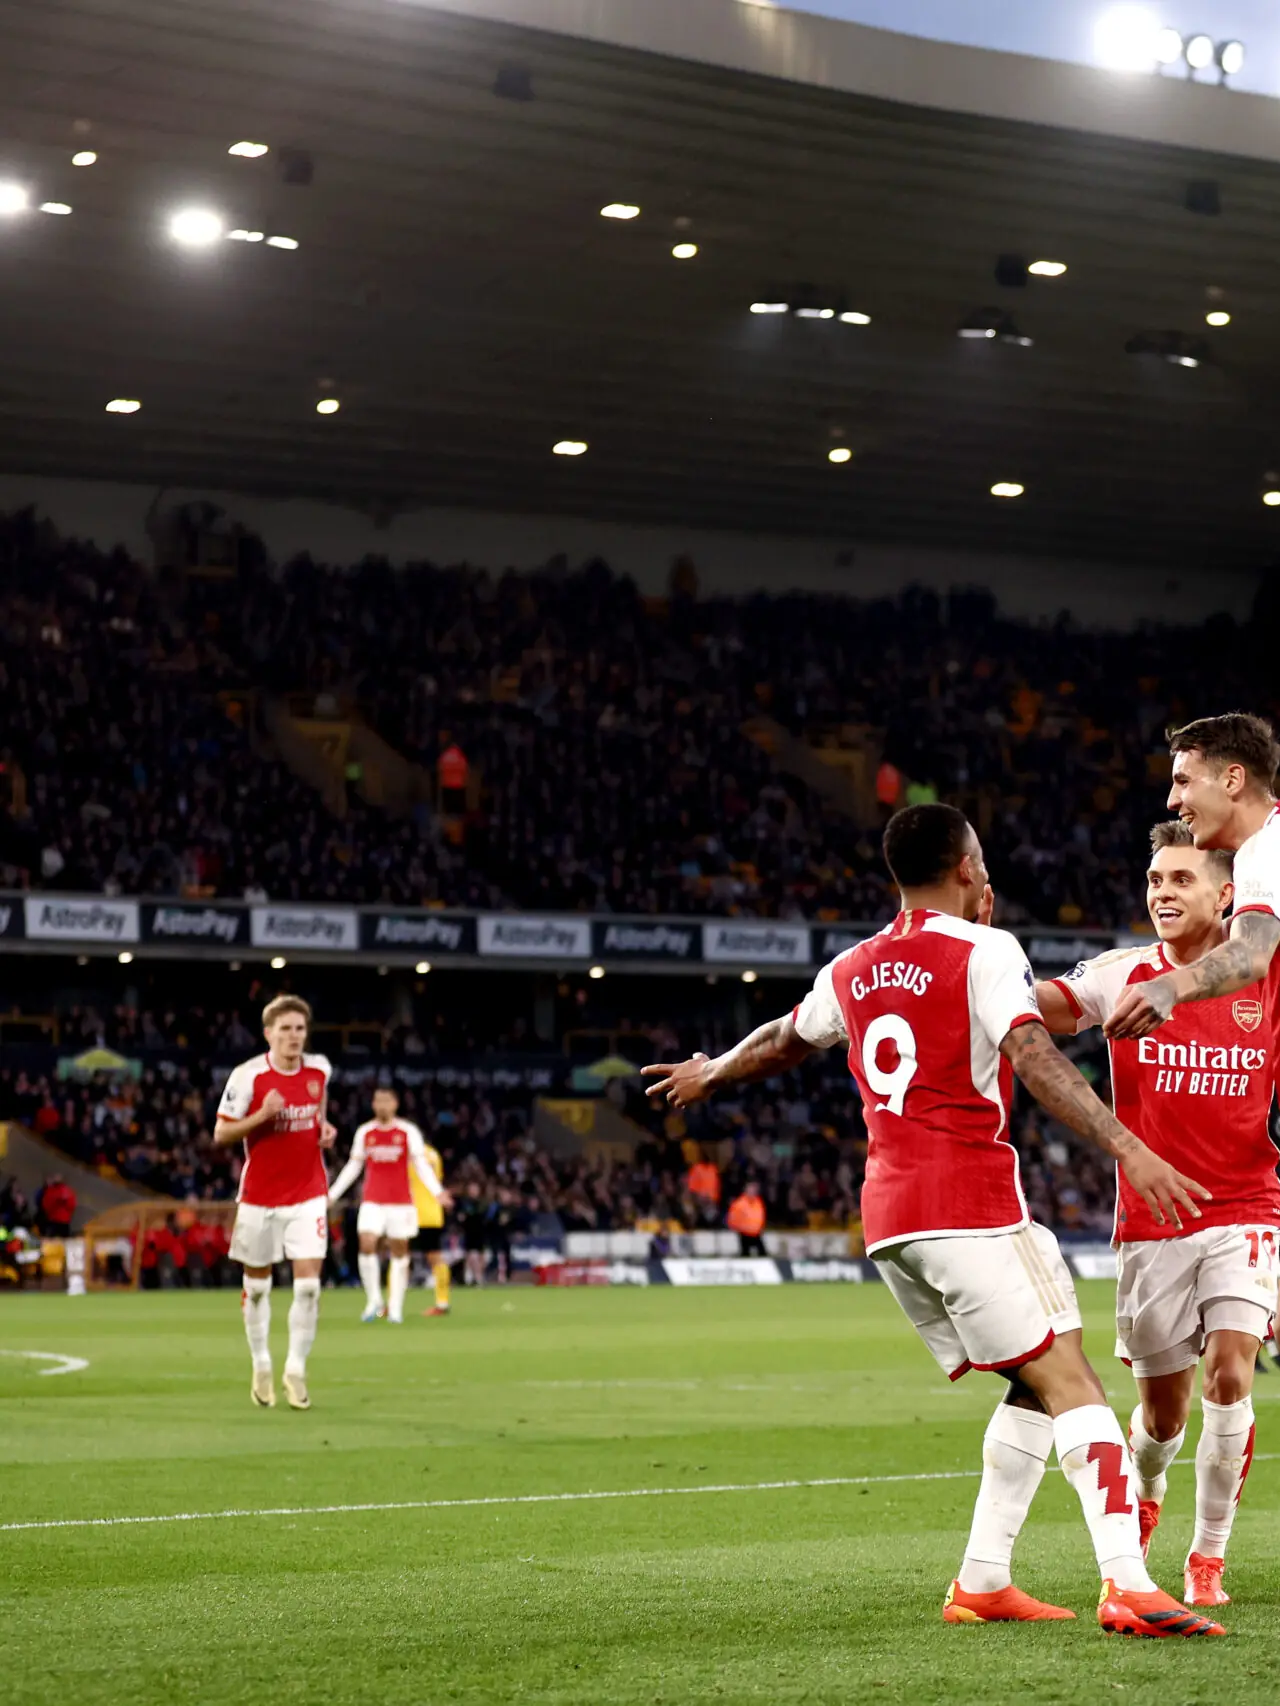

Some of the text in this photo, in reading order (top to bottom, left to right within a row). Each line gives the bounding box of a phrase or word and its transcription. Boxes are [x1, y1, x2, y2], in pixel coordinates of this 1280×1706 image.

[40, 904, 127, 938] AstroPay
[152, 908, 240, 943] AstroPay
[851, 961, 933, 1001] G.JESUS
[862, 1013, 918, 1118] 9
[1137, 1036, 1267, 1071] Emirates
[1154, 1068, 1250, 1097] FLY BETTER
